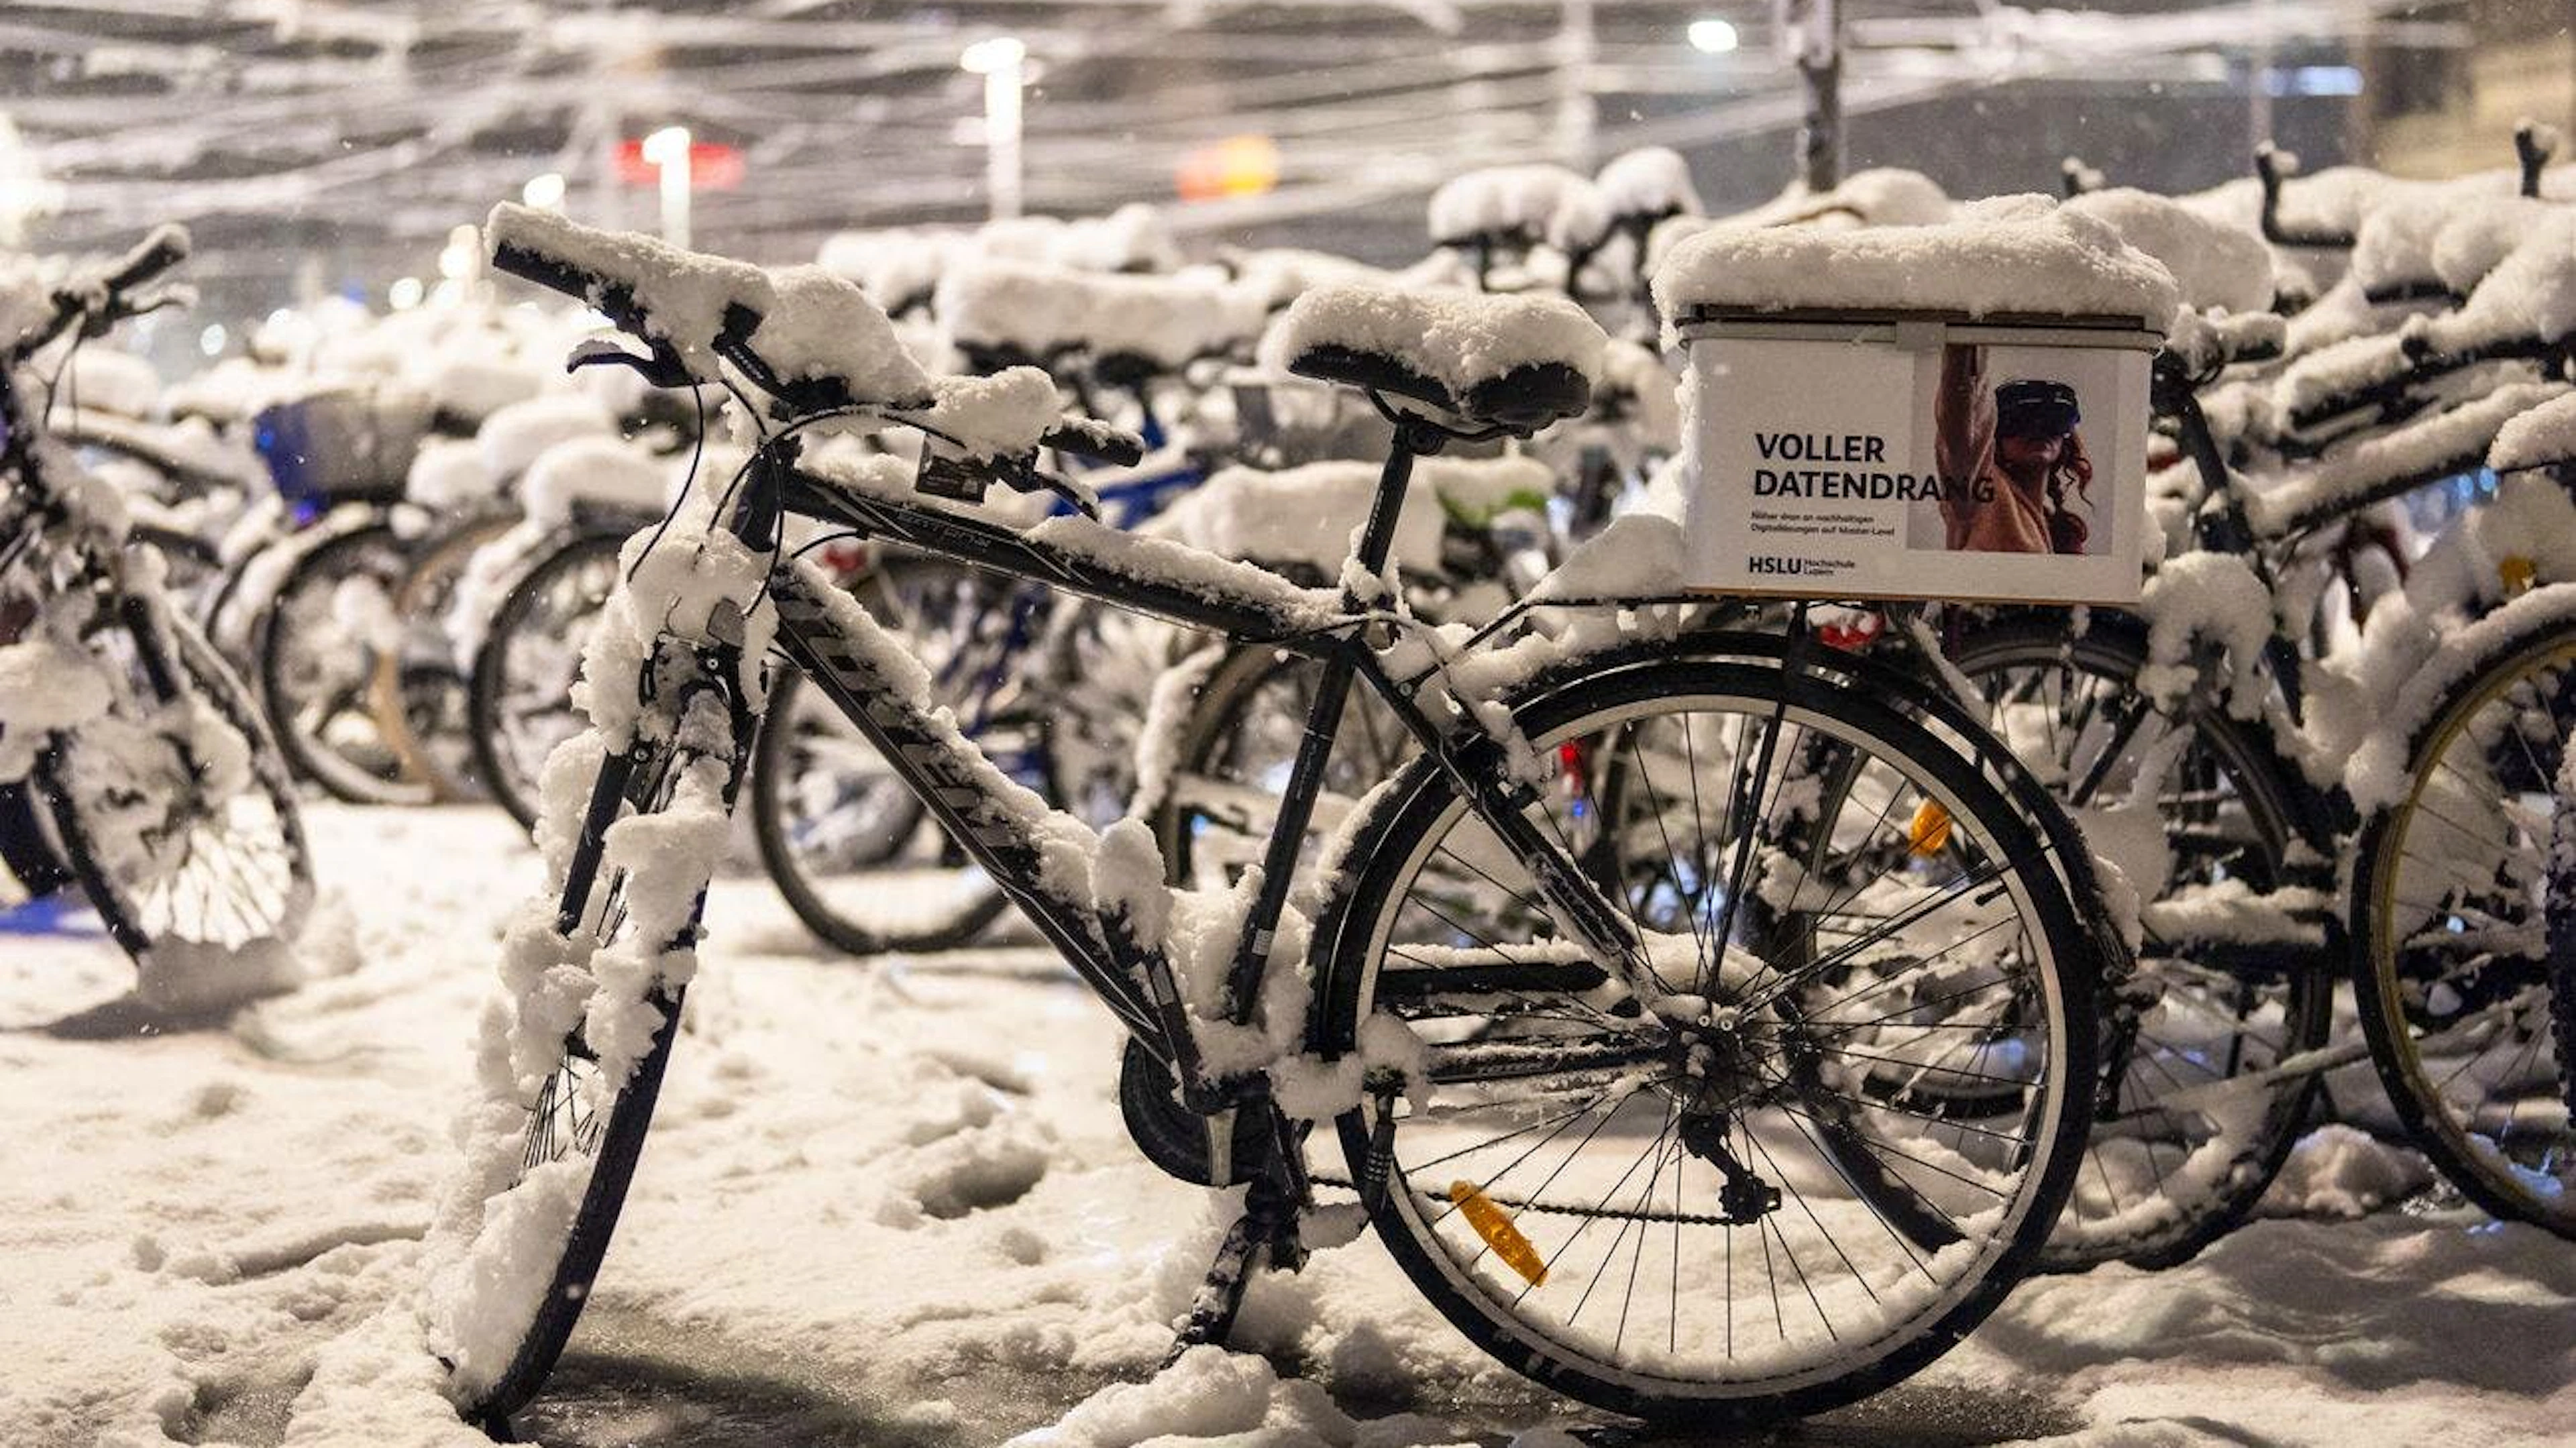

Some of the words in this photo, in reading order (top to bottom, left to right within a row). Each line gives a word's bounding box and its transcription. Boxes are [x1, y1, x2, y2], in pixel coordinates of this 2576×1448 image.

[1755, 433, 1885, 462] VOLLER
[1754, 470, 1994, 503] DATENDRANG
[1750, 557, 1801, 575] HSLU
[1805, 559, 1856, 568] Hochschule
